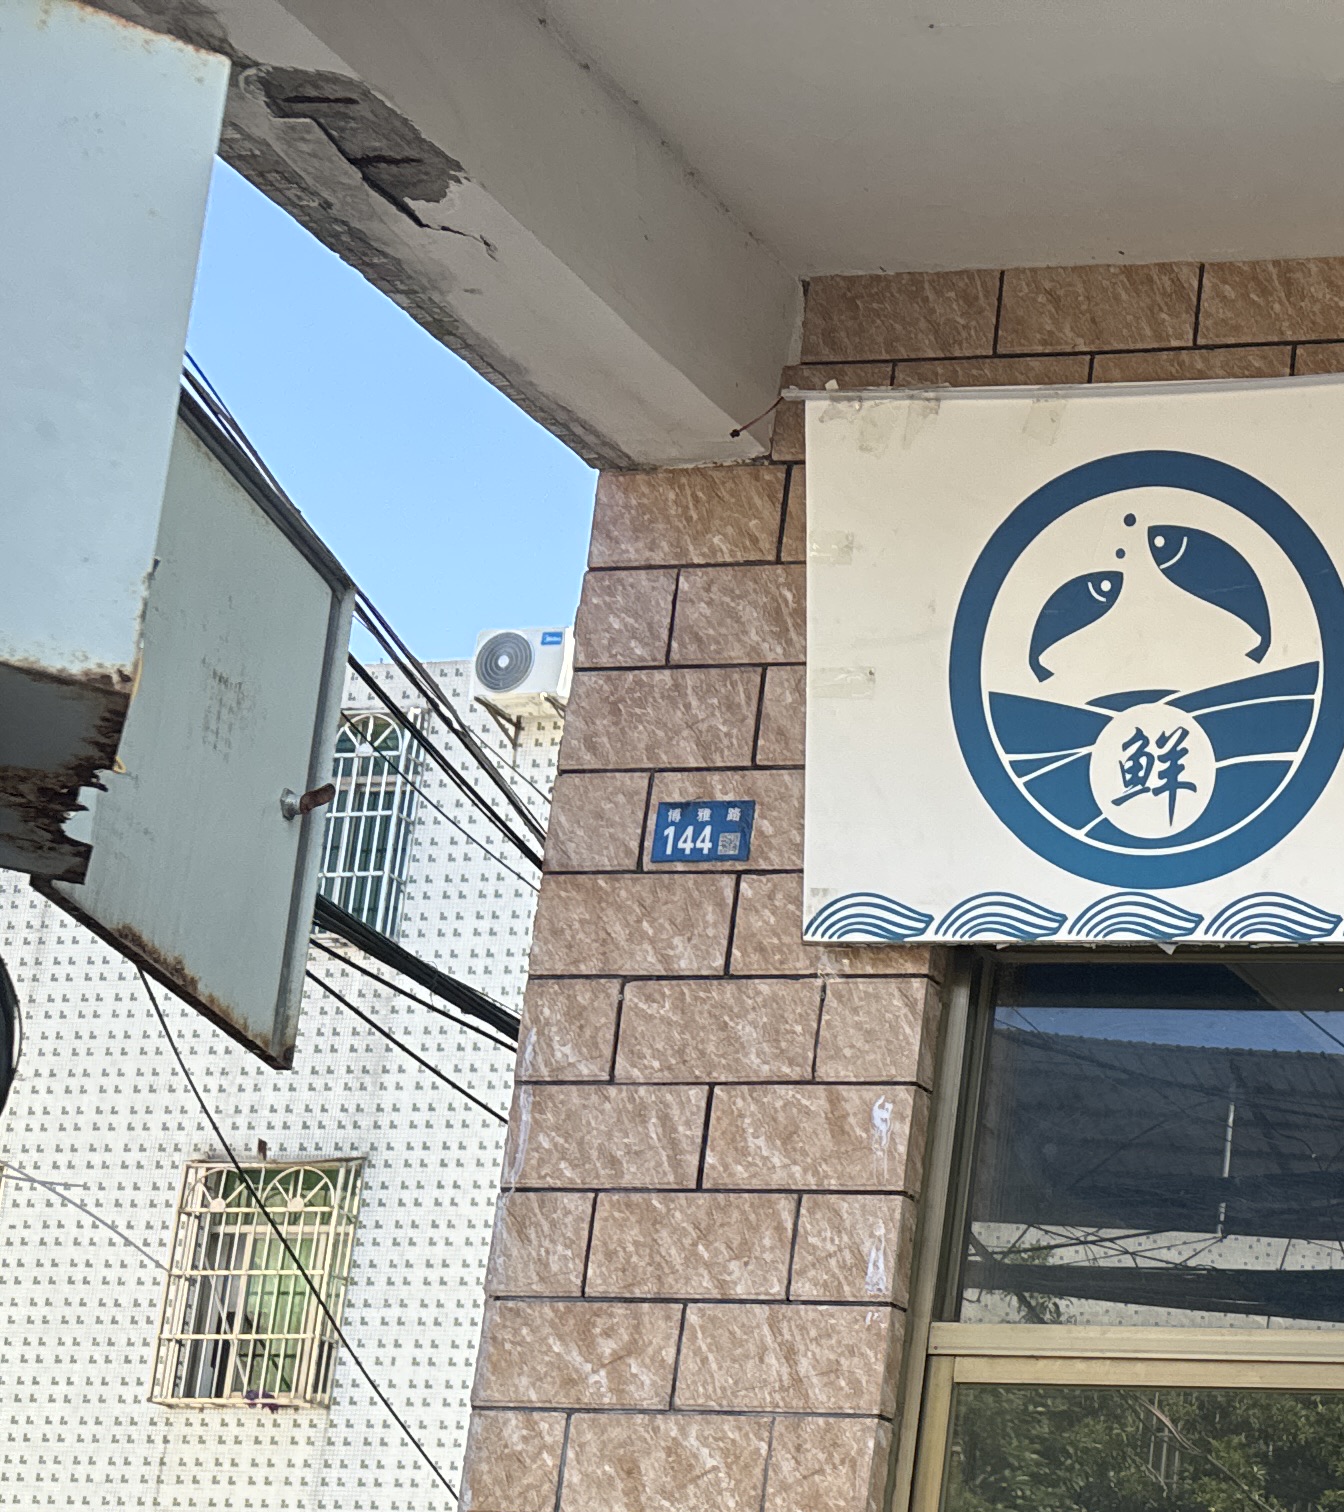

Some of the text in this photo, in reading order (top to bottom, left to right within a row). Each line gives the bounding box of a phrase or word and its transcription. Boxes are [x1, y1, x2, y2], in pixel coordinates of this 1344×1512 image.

[1110, 726, 1197, 829] 鲜
[668, 807, 742, 822] 博雅路
[663, 825, 713, 855] 144
